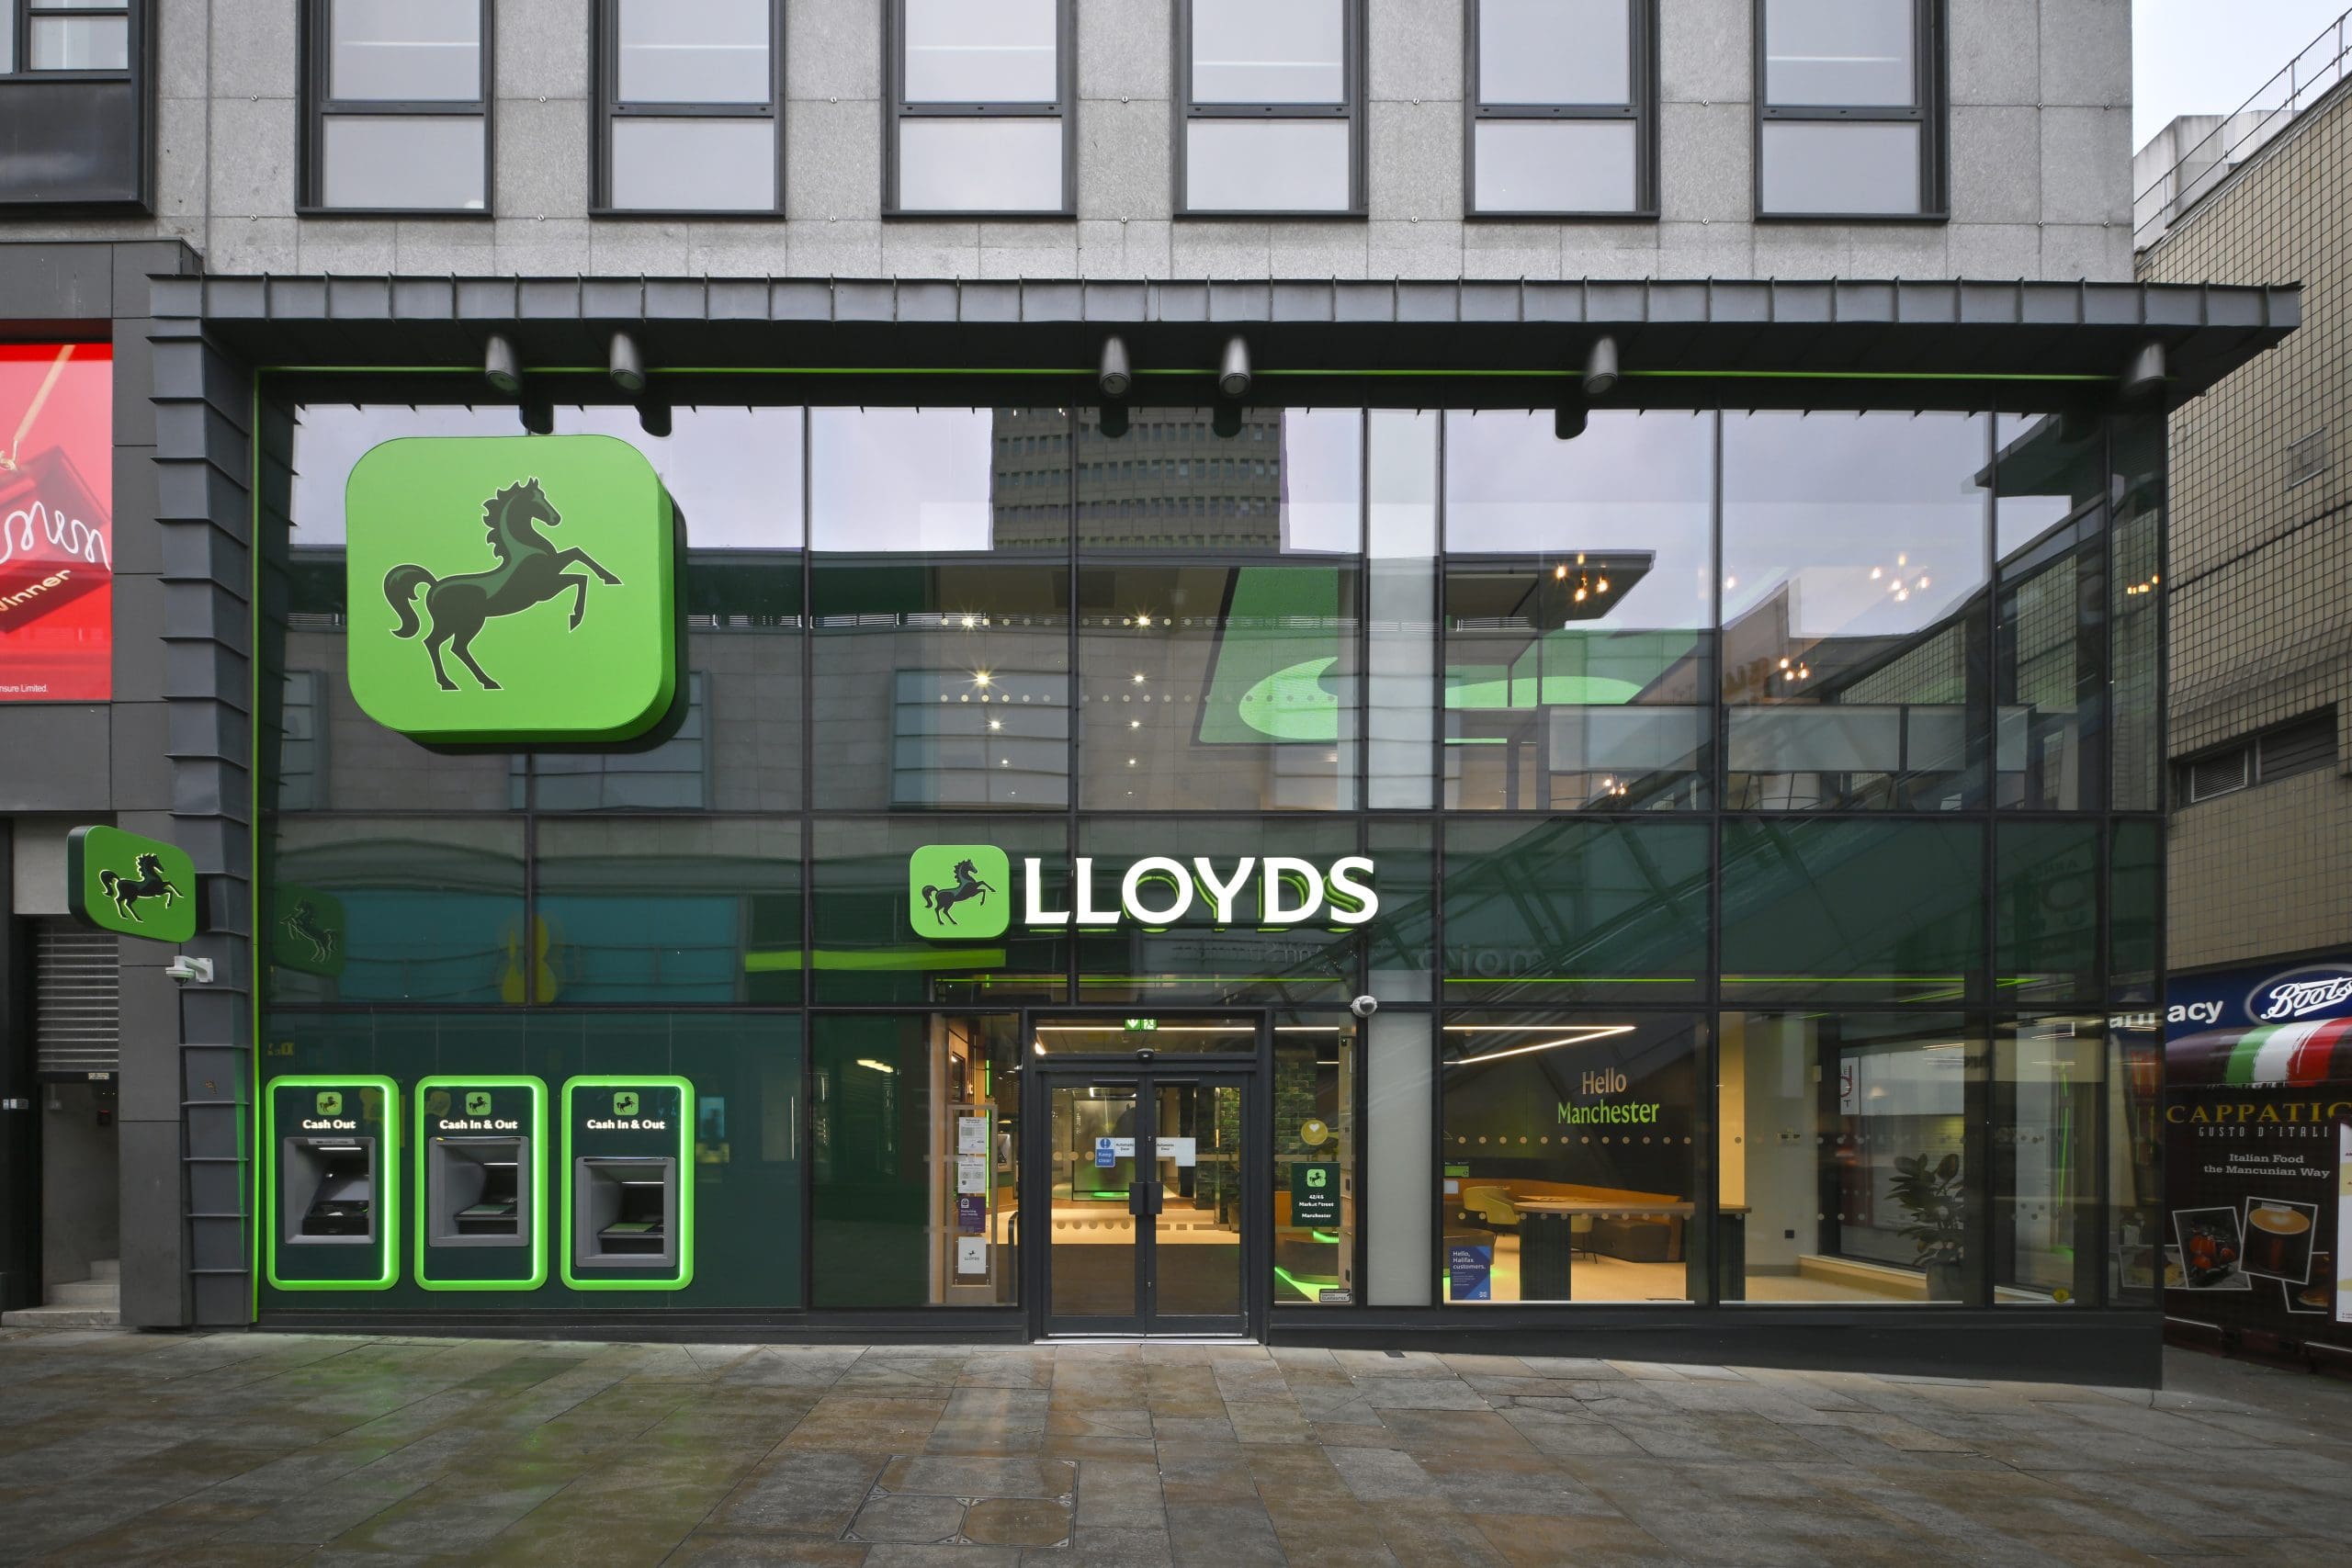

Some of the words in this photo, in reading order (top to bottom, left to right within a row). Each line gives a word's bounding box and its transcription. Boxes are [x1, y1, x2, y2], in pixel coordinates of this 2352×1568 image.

[20, 684, 48, 693] Limited.
[1023, 856, 1379, 926] LLOYDS
[2260, 977, 2352, 1020] Boots
[1582, 1066, 1627, 1095] Hello
[1557, 1099, 1660, 1124] Manchester
[302, 1119, 332, 1130] Cash
[333, 1119, 356, 1130] Out
[439, 1119, 468, 1130] Cash
[469, 1119, 482, 1130] In
[483, 1119, 493, 1130] &
[494, 1119, 518, 1130] Out
[587, 1119, 616, 1130] Cash
[617, 1119, 629, 1130] In
[630, 1119, 640, 1130] &
[641, 1119, 665, 1130] Out
[2199, 1126, 2245, 1137] GUSTO
[2229, 1153, 2269, 1163] Italian
[2273, 1154, 2304, 1164] Food
[2203, 1165, 2222, 1173] the
[2225, 1165, 2297, 1176] Mancunian
[2300, 1168, 2331, 1179] Way
